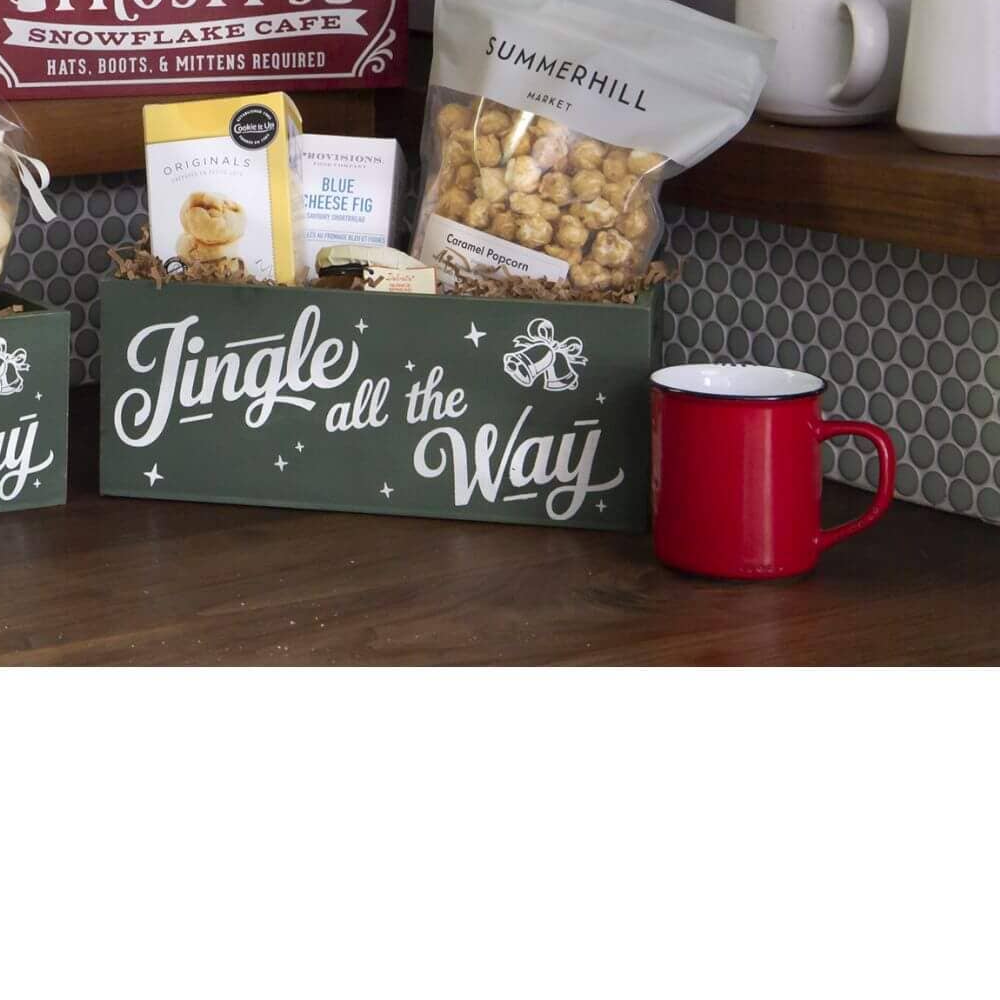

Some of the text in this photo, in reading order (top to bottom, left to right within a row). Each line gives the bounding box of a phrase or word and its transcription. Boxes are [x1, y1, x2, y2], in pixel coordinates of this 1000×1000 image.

[28, 15, 341, 45] SNOWFLAKE CAFE
[47, 51, 326, 75] HATS, BOOTS, & MITTENS REQUIRED
[486, 35, 647, 112] SUMMERHILL
[526, 91, 573, 112] MARKET
[163, 156, 251, 176] ORIGINALS
[322, 177, 355, 193] BLUE
[352, 197, 373, 213] FIG
[446, 233, 529, 272] Caramel Popcorn
[113, 304, 359, 448] Jingle
[325, 366, 468, 433] all the
[413, 405, 625, 521] Way
